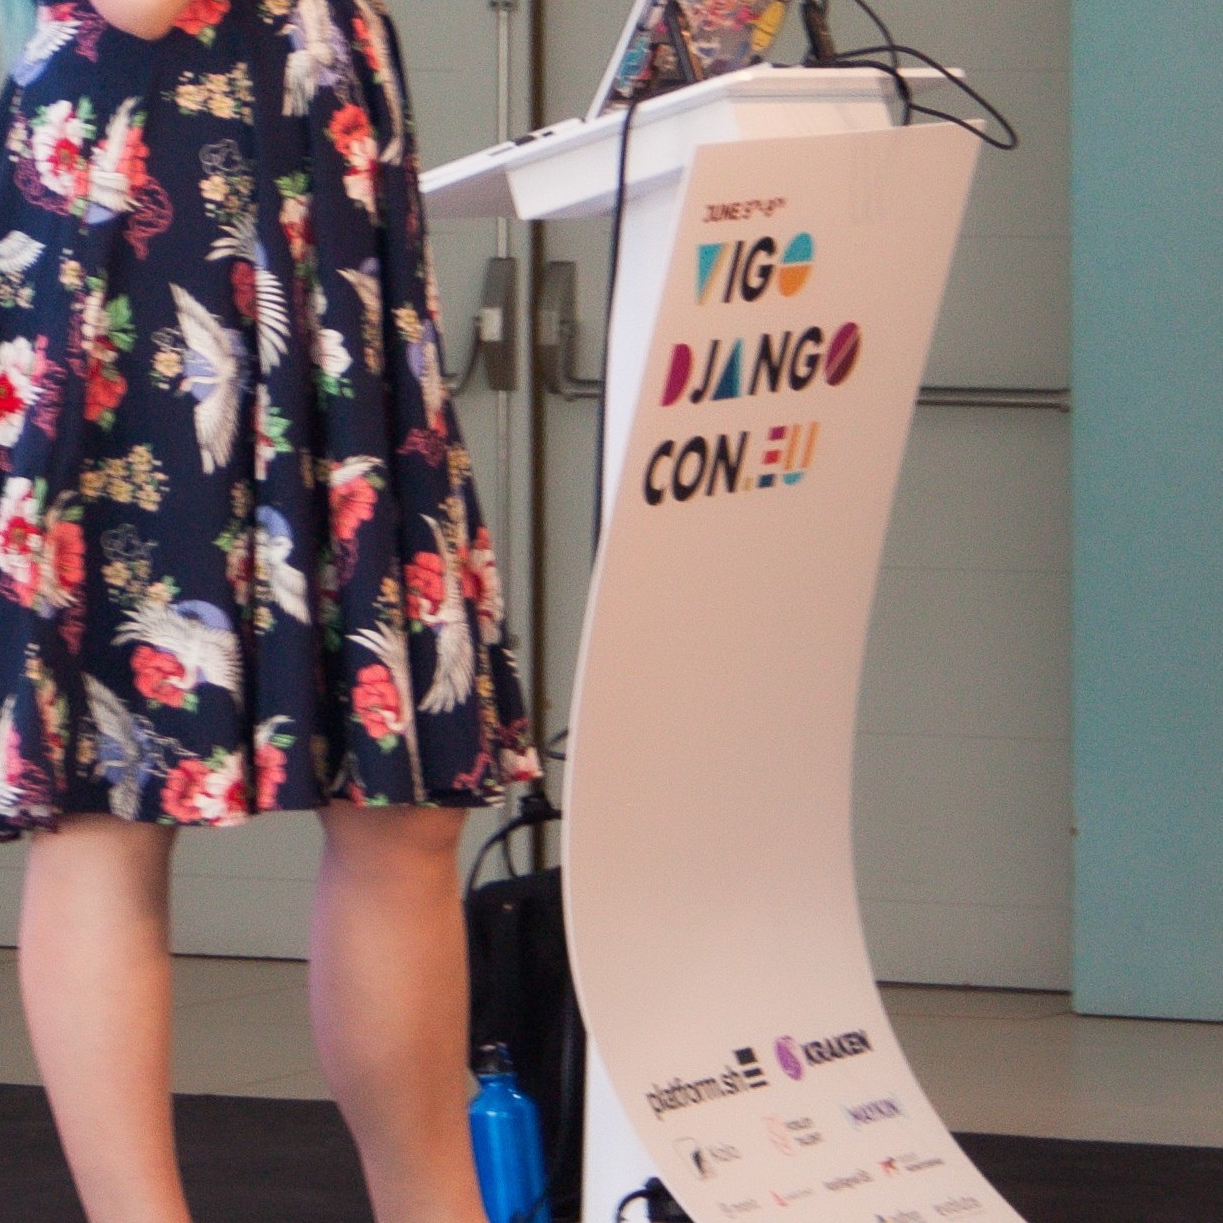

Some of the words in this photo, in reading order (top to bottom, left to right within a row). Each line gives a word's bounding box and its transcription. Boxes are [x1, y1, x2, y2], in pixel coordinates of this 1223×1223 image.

[695, 231, 815, 306] VIGO
[659, 321, 861, 408] DJANGO
[801, 1029, 874, 1066] KRAKEN
[645, 1066, 748, 1121] platform.sh
